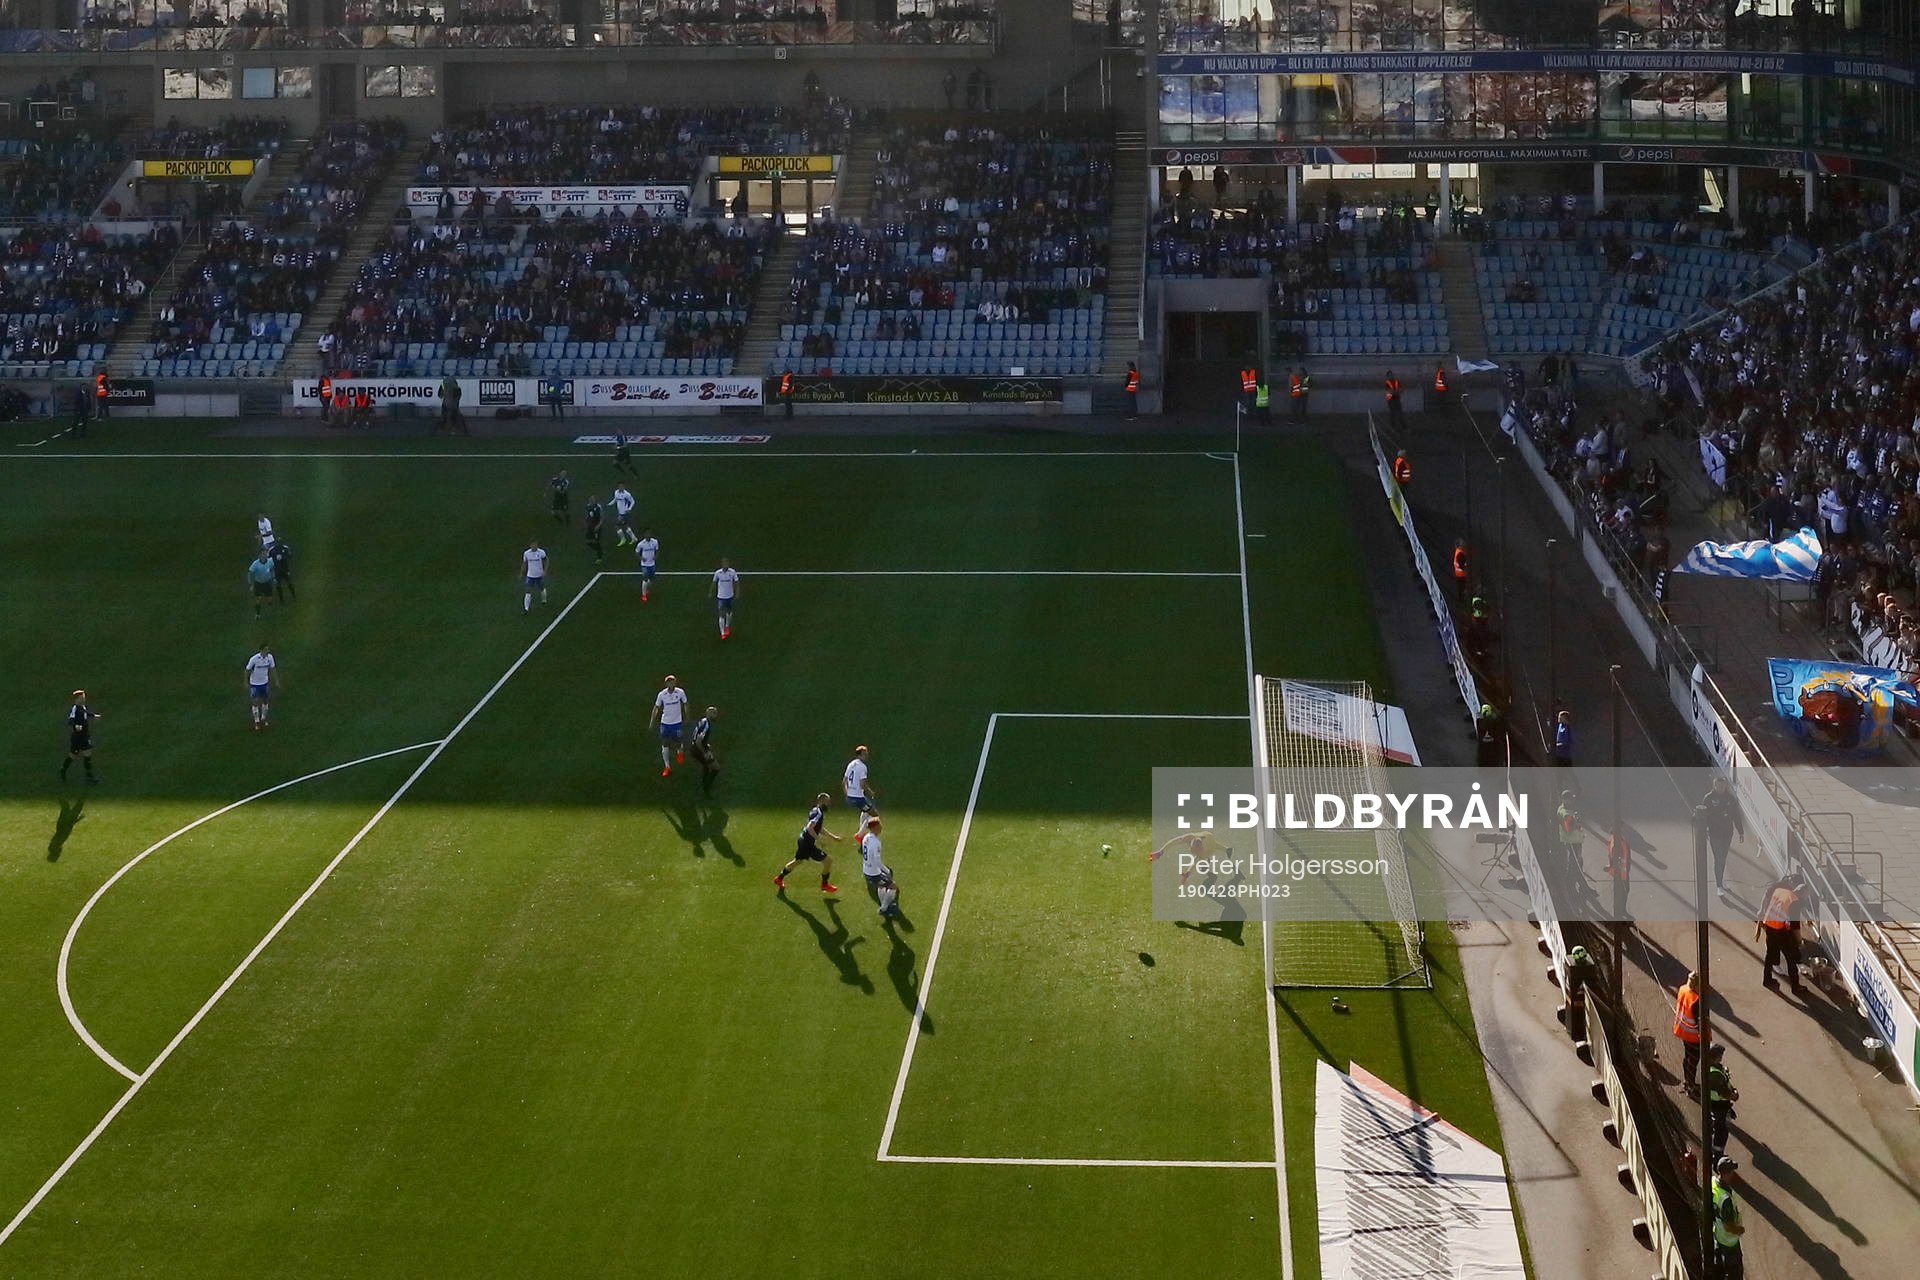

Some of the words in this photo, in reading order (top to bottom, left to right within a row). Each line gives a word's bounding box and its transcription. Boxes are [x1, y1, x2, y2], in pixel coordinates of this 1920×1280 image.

[1250, 57, 1259, 70] VI
[1260, 57, 1277, 70] UPP
[1288, 57, 1301, 69] BLI
[1303, 57, 1313, 69] EN
[1315, 57, 1329, 69] DEL
[1331, 57, 1342, 69] AV
[1184, 150, 1219, 163] pepsi
[1408, 150, 1457, 160] MAXIMUM
[1459, 149, 1508, 159] FOOTBALL.
[1510, 149, 1559, 158] MAXIMUM
[1561, 149, 1591, 158] TASTE.
[1637, 149, 1673, 161] pepsi
[165, 161, 232, 175] PACKOPLOCK
[741, 157, 810, 171] PACKOPLOCK
[540, 382, 572, 395] HO
[867, 391, 914, 402] Kimstads
[917, 391, 939, 401] VVS
[943, 391, 959, 401] AB
[848, 770, 854, 784] 4
